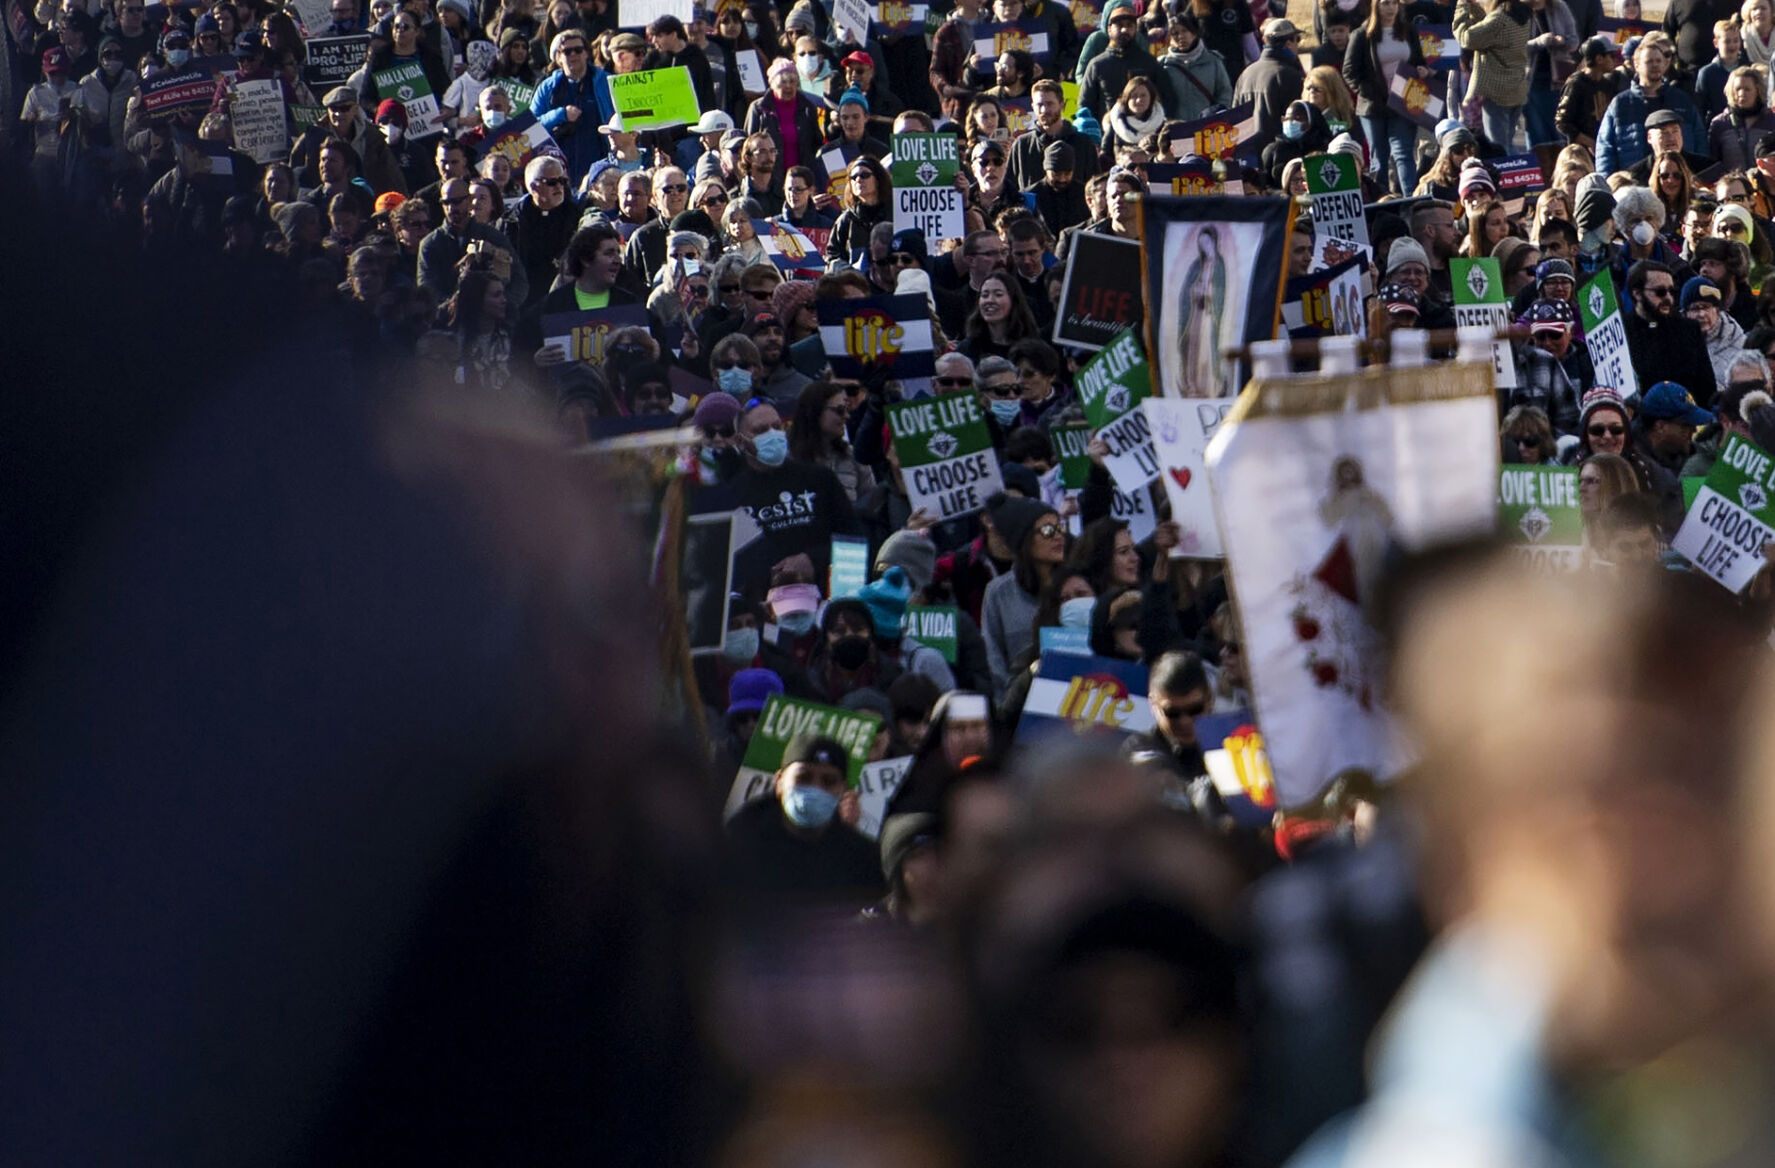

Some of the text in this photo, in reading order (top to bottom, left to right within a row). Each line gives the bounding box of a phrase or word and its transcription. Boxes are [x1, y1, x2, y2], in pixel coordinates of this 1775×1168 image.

[878, 2, 914, 27] life
[322, 46, 340, 55] AM
[344, 43, 367, 53] THE
[376, 64, 424, 88] AMA LA VIDA
[613, 71, 655, 88] AGAINST
[418, 100, 431, 115] LA
[515, 85, 534, 105] LIF
[409, 118, 429, 136] VIDA
[1194, 125, 1239, 160] life
[894, 137, 956, 161] LOVE LIFE
[900, 188, 956, 213] CHOOSE
[1313, 192, 1363, 222] DEFEND
[914, 214, 943, 238] LIFE
[1077, 284, 1131, 322] LIFE
[844, 316, 904, 365] life
[1080, 312, 1137, 336] beautifl
[572, 324, 608, 366] lif
[1588, 317, 1624, 367] DEFEND
[1077, 335, 1142, 407] LOVE LIFE
[1603, 356, 1624, 392] LIFE
[889, 394, 980, 437] LOVE LIFE
[1056, 430, 1089, 458] LOV
[1101, 410, 1152, 459] CHOO
[913, 454, 990, 496] CHOOSE
[1133, 441, 1160, 477] LI
[1722, 436, 1771, 483] LOVE
[938, 485, 978, 517] LIFE
[1112, 488, 1144, 516] OSE
[1499, 470, 1577, 508] OVE LIFE
[1700, 496, 1774, 560] CHOOSE
[1695, 533, 1740, 579] LIFE
[920, 611, 957, 638] VIDA
[1060, 676, 1135, 735] life
[762, 700, 874, 759] LOVE LIFE
